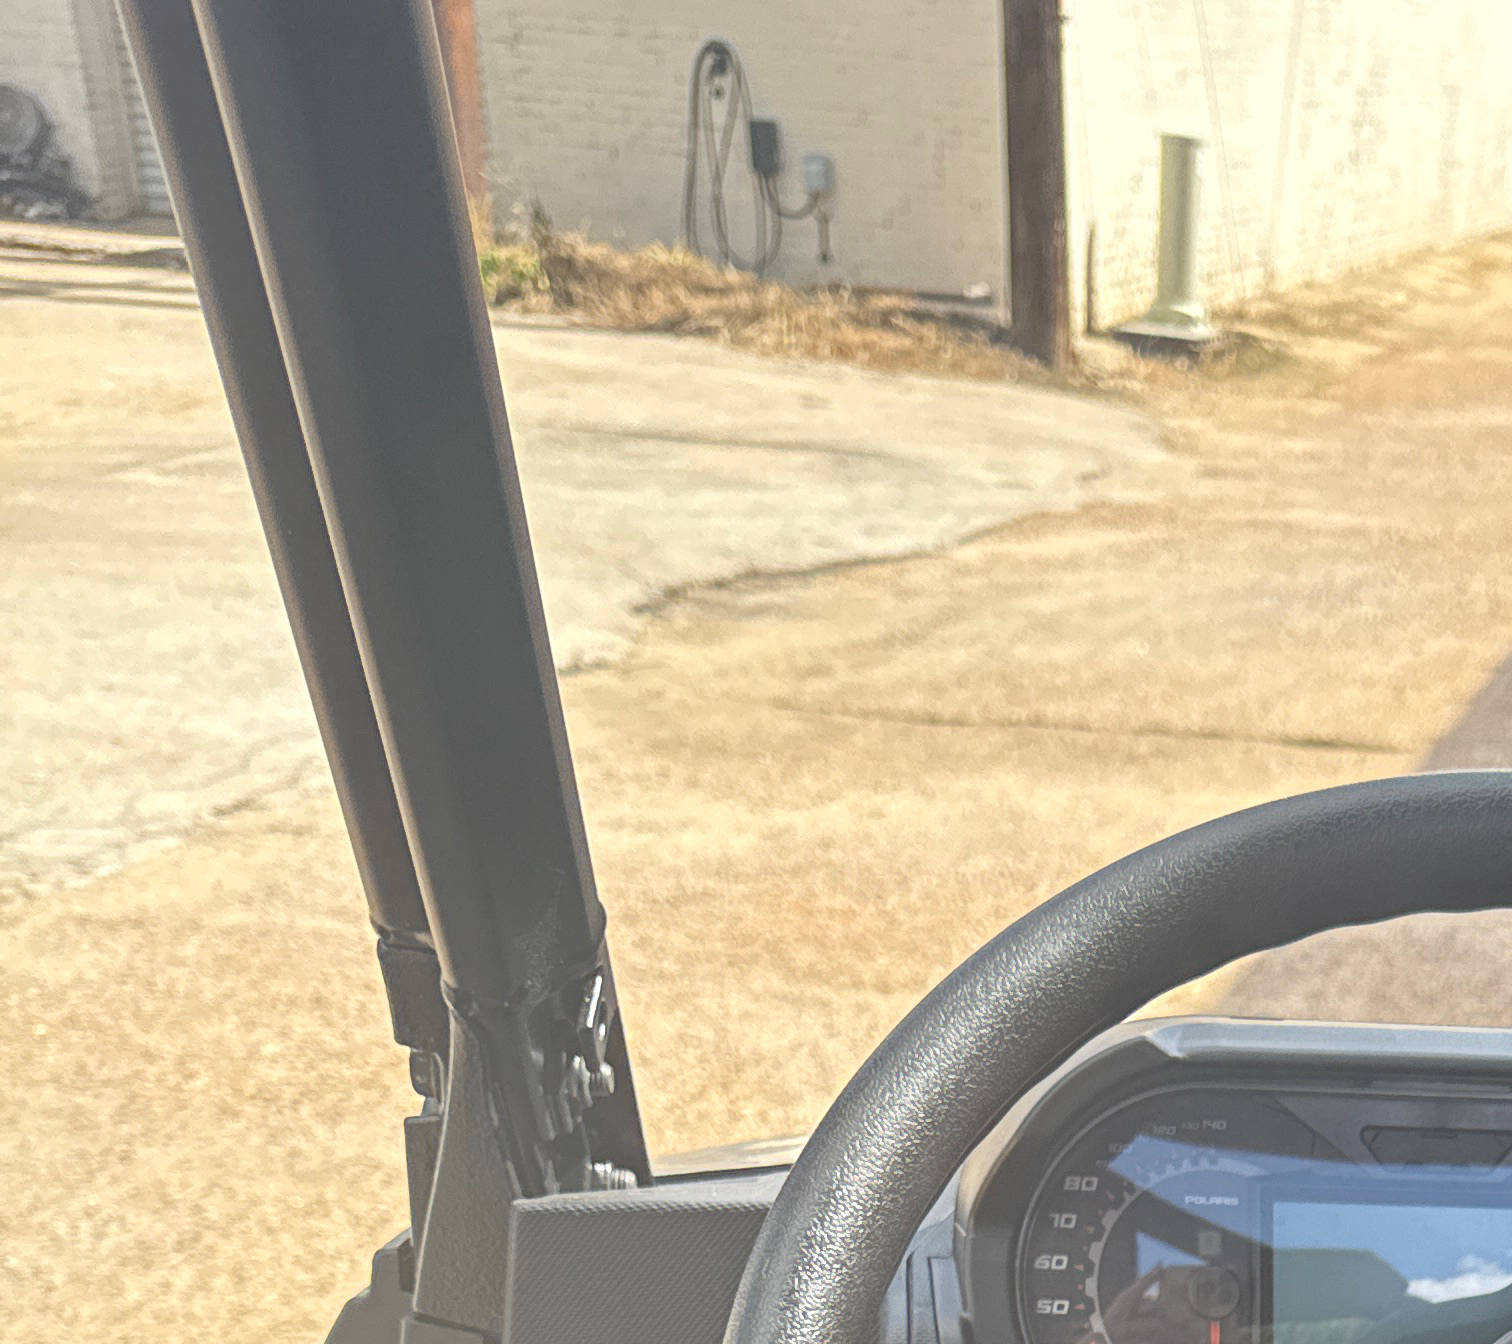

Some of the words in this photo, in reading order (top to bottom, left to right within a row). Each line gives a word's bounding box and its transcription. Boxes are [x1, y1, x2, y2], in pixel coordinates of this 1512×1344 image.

[1063, 1176, 1099, 1192] 80
[1185, 1196, 1239, 1206] POLARIS
[1050, 1213, 1078, 1229] 70
[1034, 1255, 1069, 1270] 60
[1036, 1300, 1070, 1315] 50
